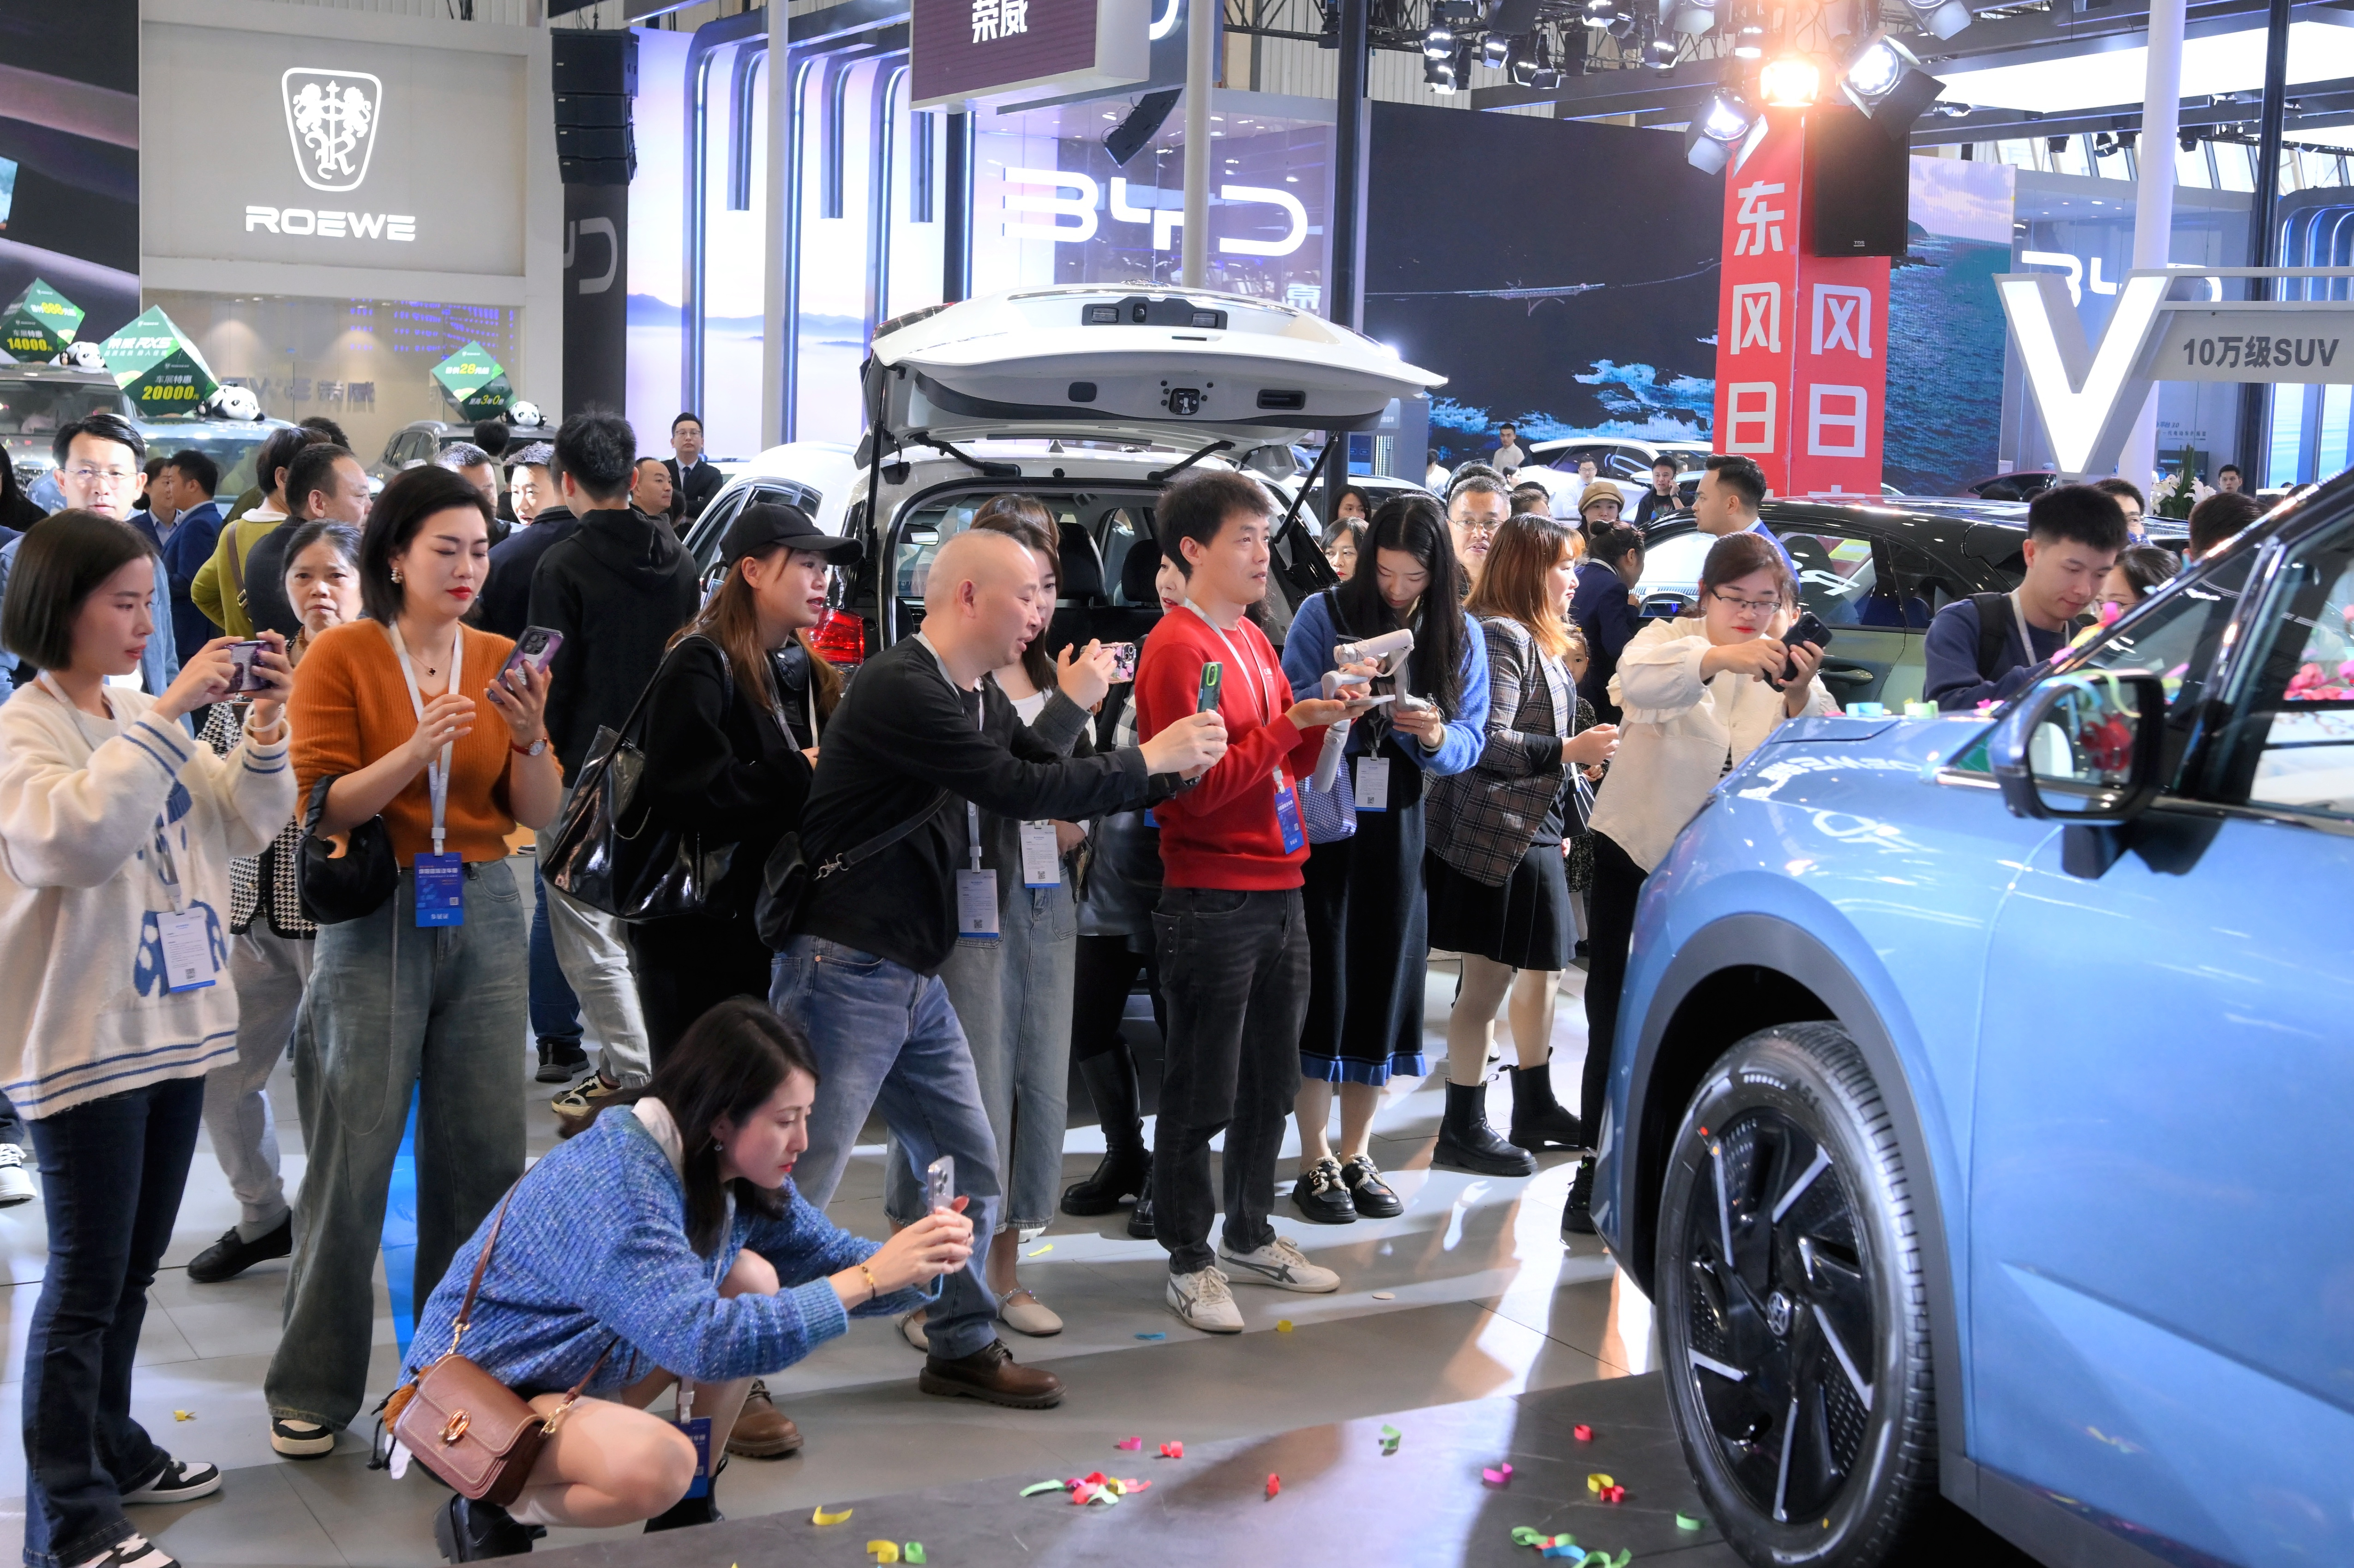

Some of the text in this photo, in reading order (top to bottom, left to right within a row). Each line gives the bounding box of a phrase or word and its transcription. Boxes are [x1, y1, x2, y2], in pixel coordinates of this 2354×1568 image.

[246, 206, 416, 241] ROEWE
[1727, 180, 1785, 500] 东风日
[2183, 336, 2339, 368] 10万级SUV
[155, 375, 192, 384] 车展特惠
[2001, 276, 2169, 473] V
[142, 385, 199, 400] 20000元
